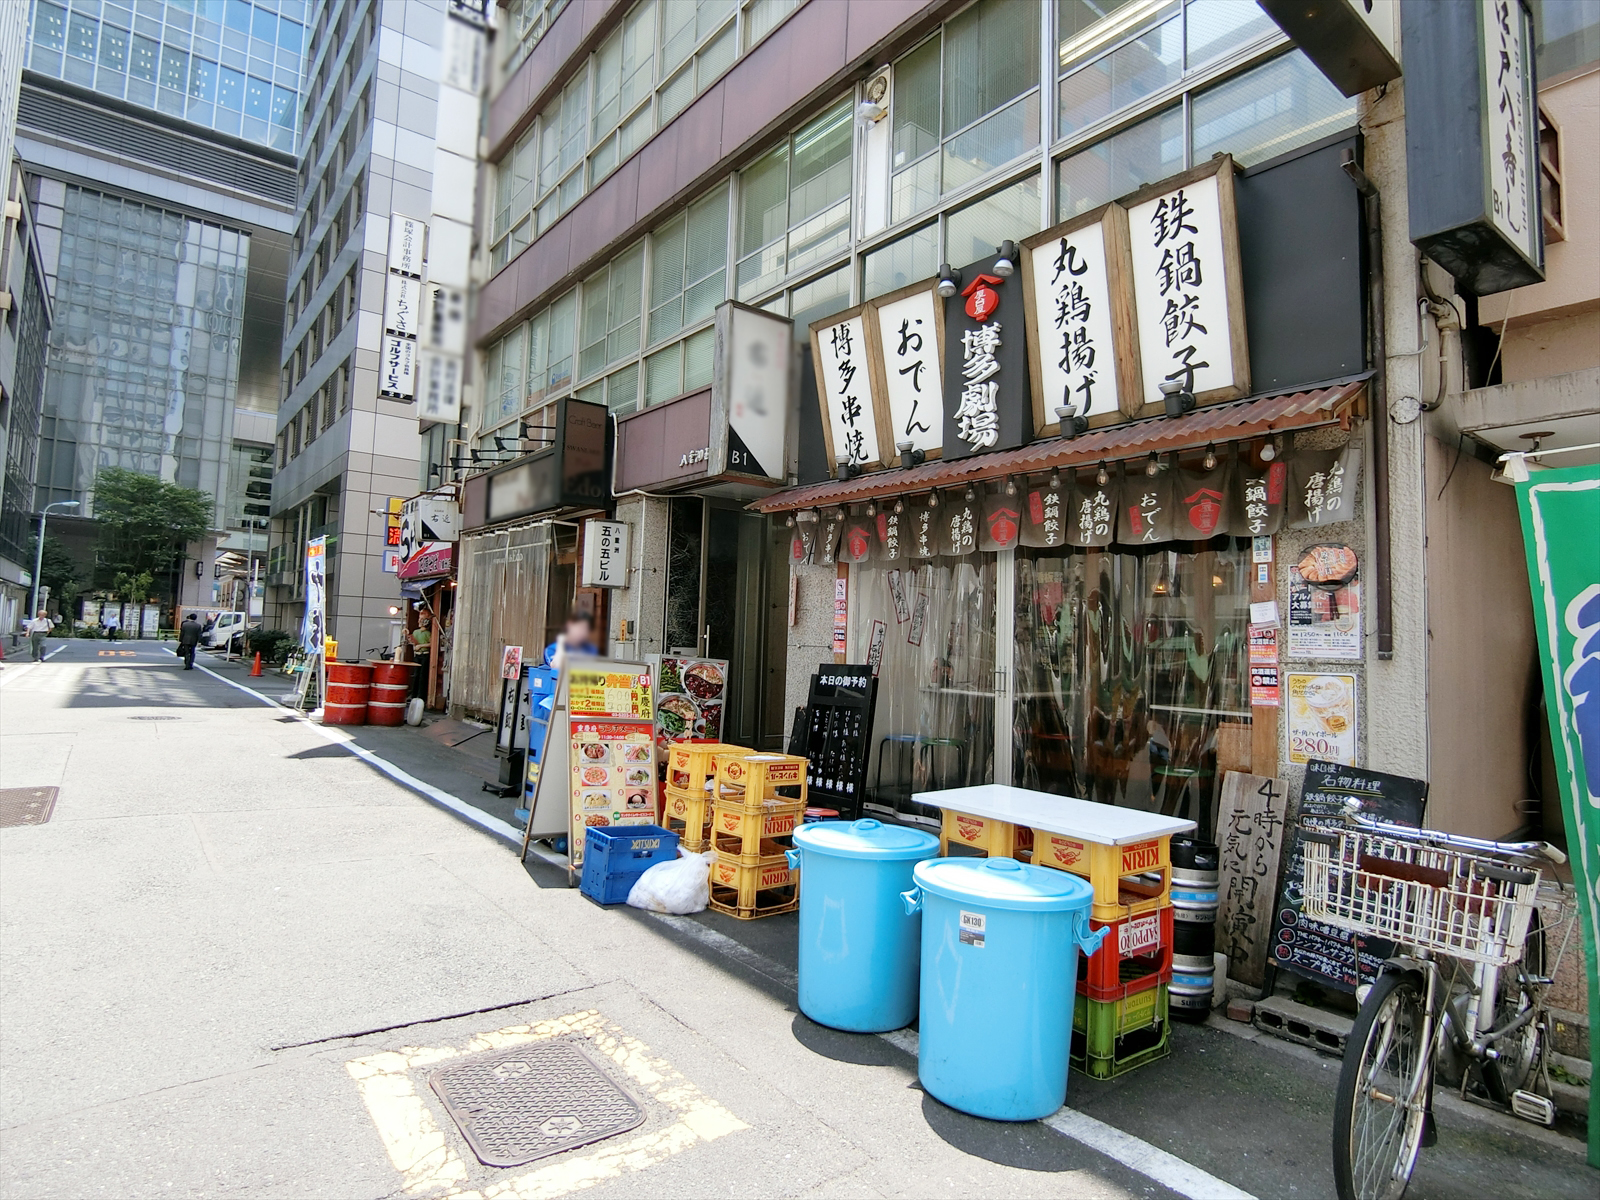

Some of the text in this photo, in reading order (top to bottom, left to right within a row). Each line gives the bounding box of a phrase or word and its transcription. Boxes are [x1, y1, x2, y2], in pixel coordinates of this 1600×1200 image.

[1493, 189, 1504, 219] B1
[1150, 190, 1209, 396] 鉄鍋餃子
[1051, 238, 1099, 416] 丸鶏揚げ
[387, 340, 402, 389] ゴルフサービス
[897, 317, 932, 438] おでん
[953, 321, 1003, 452] 博多劇場
[830, 324, 869, 464] 博多串焼
[731, 450, 748, 466] B1
[1304, 472, 1326, 523] 唐揚げ
[1326, 461, 1344, 511] 丸鶏の
[918, 510, 931, 557] 博多串焼
[950, 507, 974, 554] 丸鶏の 唐揚げ
[1043, 493, 1060, 545] 鉄鍋餃子
[1079, 499, 1093, 544] 唐揚げ
[1092, 491, 1110, 536] 丸鶏の
[1140, 492, 1161, 541] おでん
[599, 525, 612, 582] 五の五ビル
[613, 527, 621, 554] 八重洲
[823, 523, 836, 563] 博多串焼
[887, 515, 899, 559] 鉄鍋餃子
[640, 675, 651, 685] B1
[820, 675, 867, 688] 本日の御予約
[1292, 737, 1339, 756] 280円
[1321, 774, 1381, 792] 名物料理
[764, 818, 795, 834] KIRIN
[1253, 779, 1283, 876] 4時から
[762, 871, 790, 886] KIRIN
[1122, 847, 1160, 872] KIRIN
